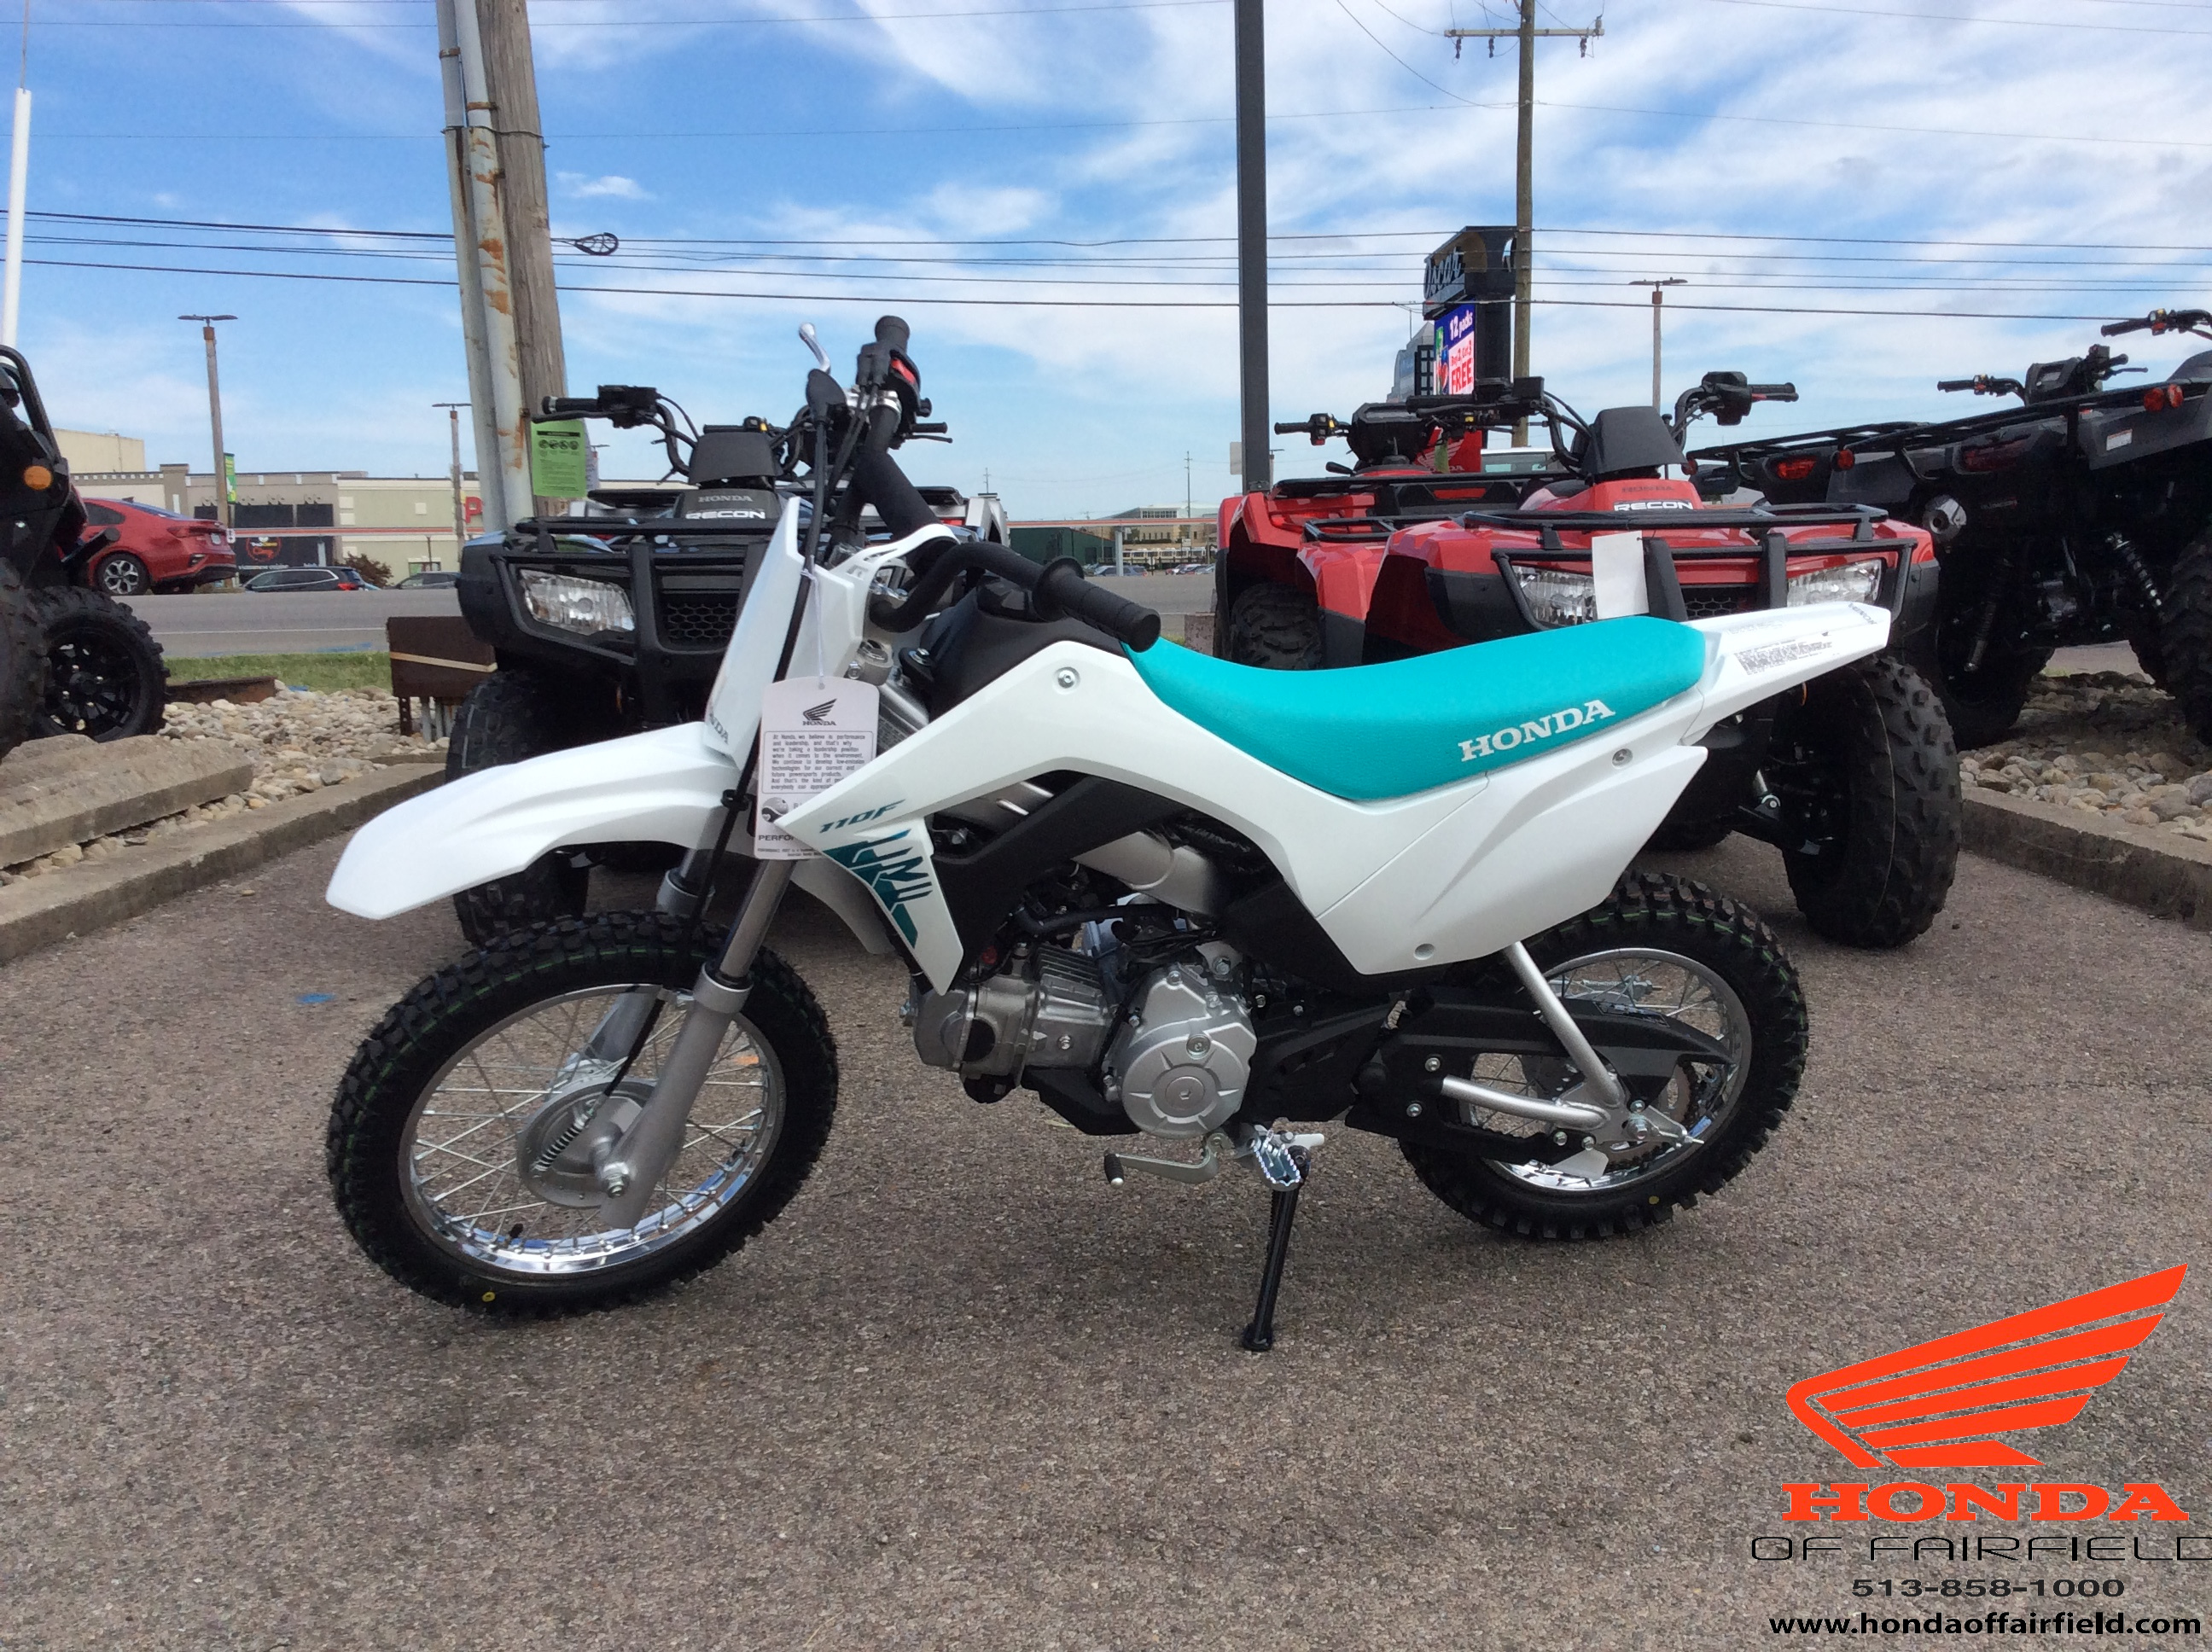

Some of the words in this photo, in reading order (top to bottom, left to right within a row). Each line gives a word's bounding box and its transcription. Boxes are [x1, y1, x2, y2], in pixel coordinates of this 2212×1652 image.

[1450, 316, 1458, 340] 12
[1459, 310, 1473, 339] packs
[1452, 358, 1472, 394] FREE
[685, 510, 765, 519] RECON
[1614, 501, 1694, 511] RECON
[1458, 699, 1616, 762] HONDA
[819, 800, 905, 833] 110F
